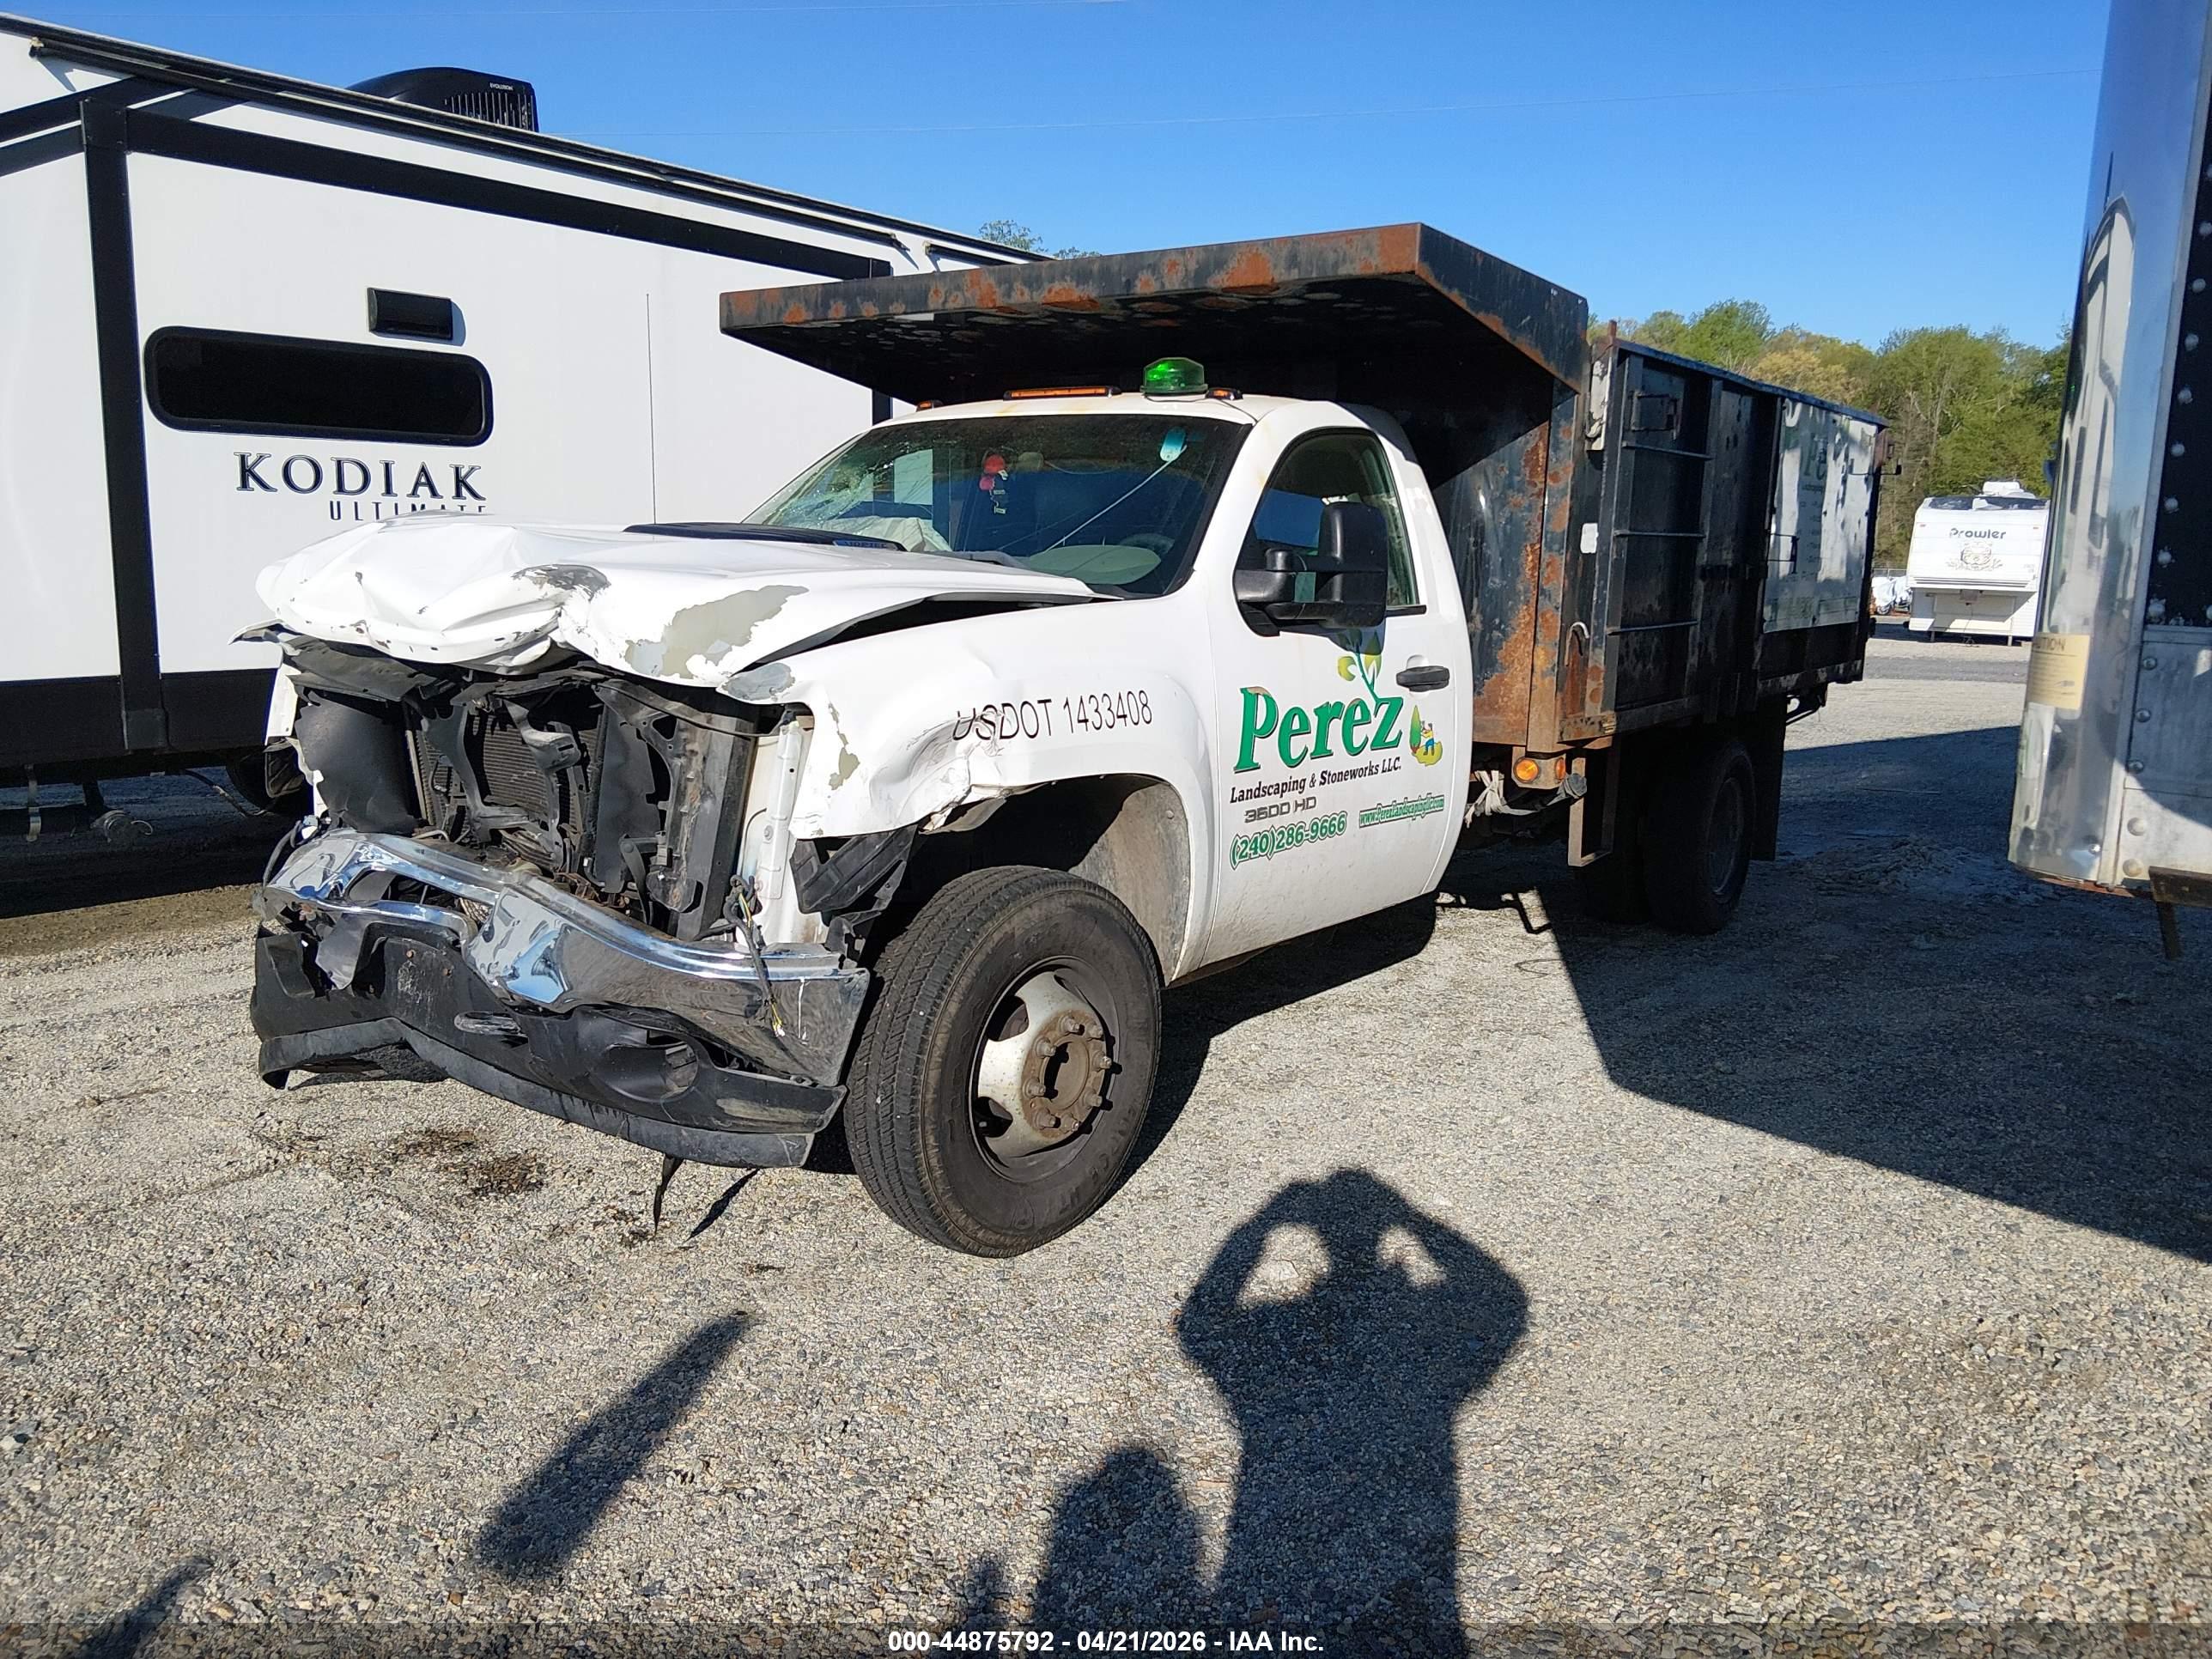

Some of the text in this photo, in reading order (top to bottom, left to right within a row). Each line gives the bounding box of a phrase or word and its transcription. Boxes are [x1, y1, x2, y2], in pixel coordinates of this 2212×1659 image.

[234, 452, 486, 501] KODIAK
[952, 690, 1152, 740] USDOT 1433408
[1234, 685, 1404, 773] Perez
[1230, 776, 1306, 804] Landscaping
[1309, 774, 1317, 788] &
[1319, 761, 1380, 787] Stoneworks
[1293, 796, 1317, 813] HD
[1231, 811, 1347, 867] (240)286-9666
